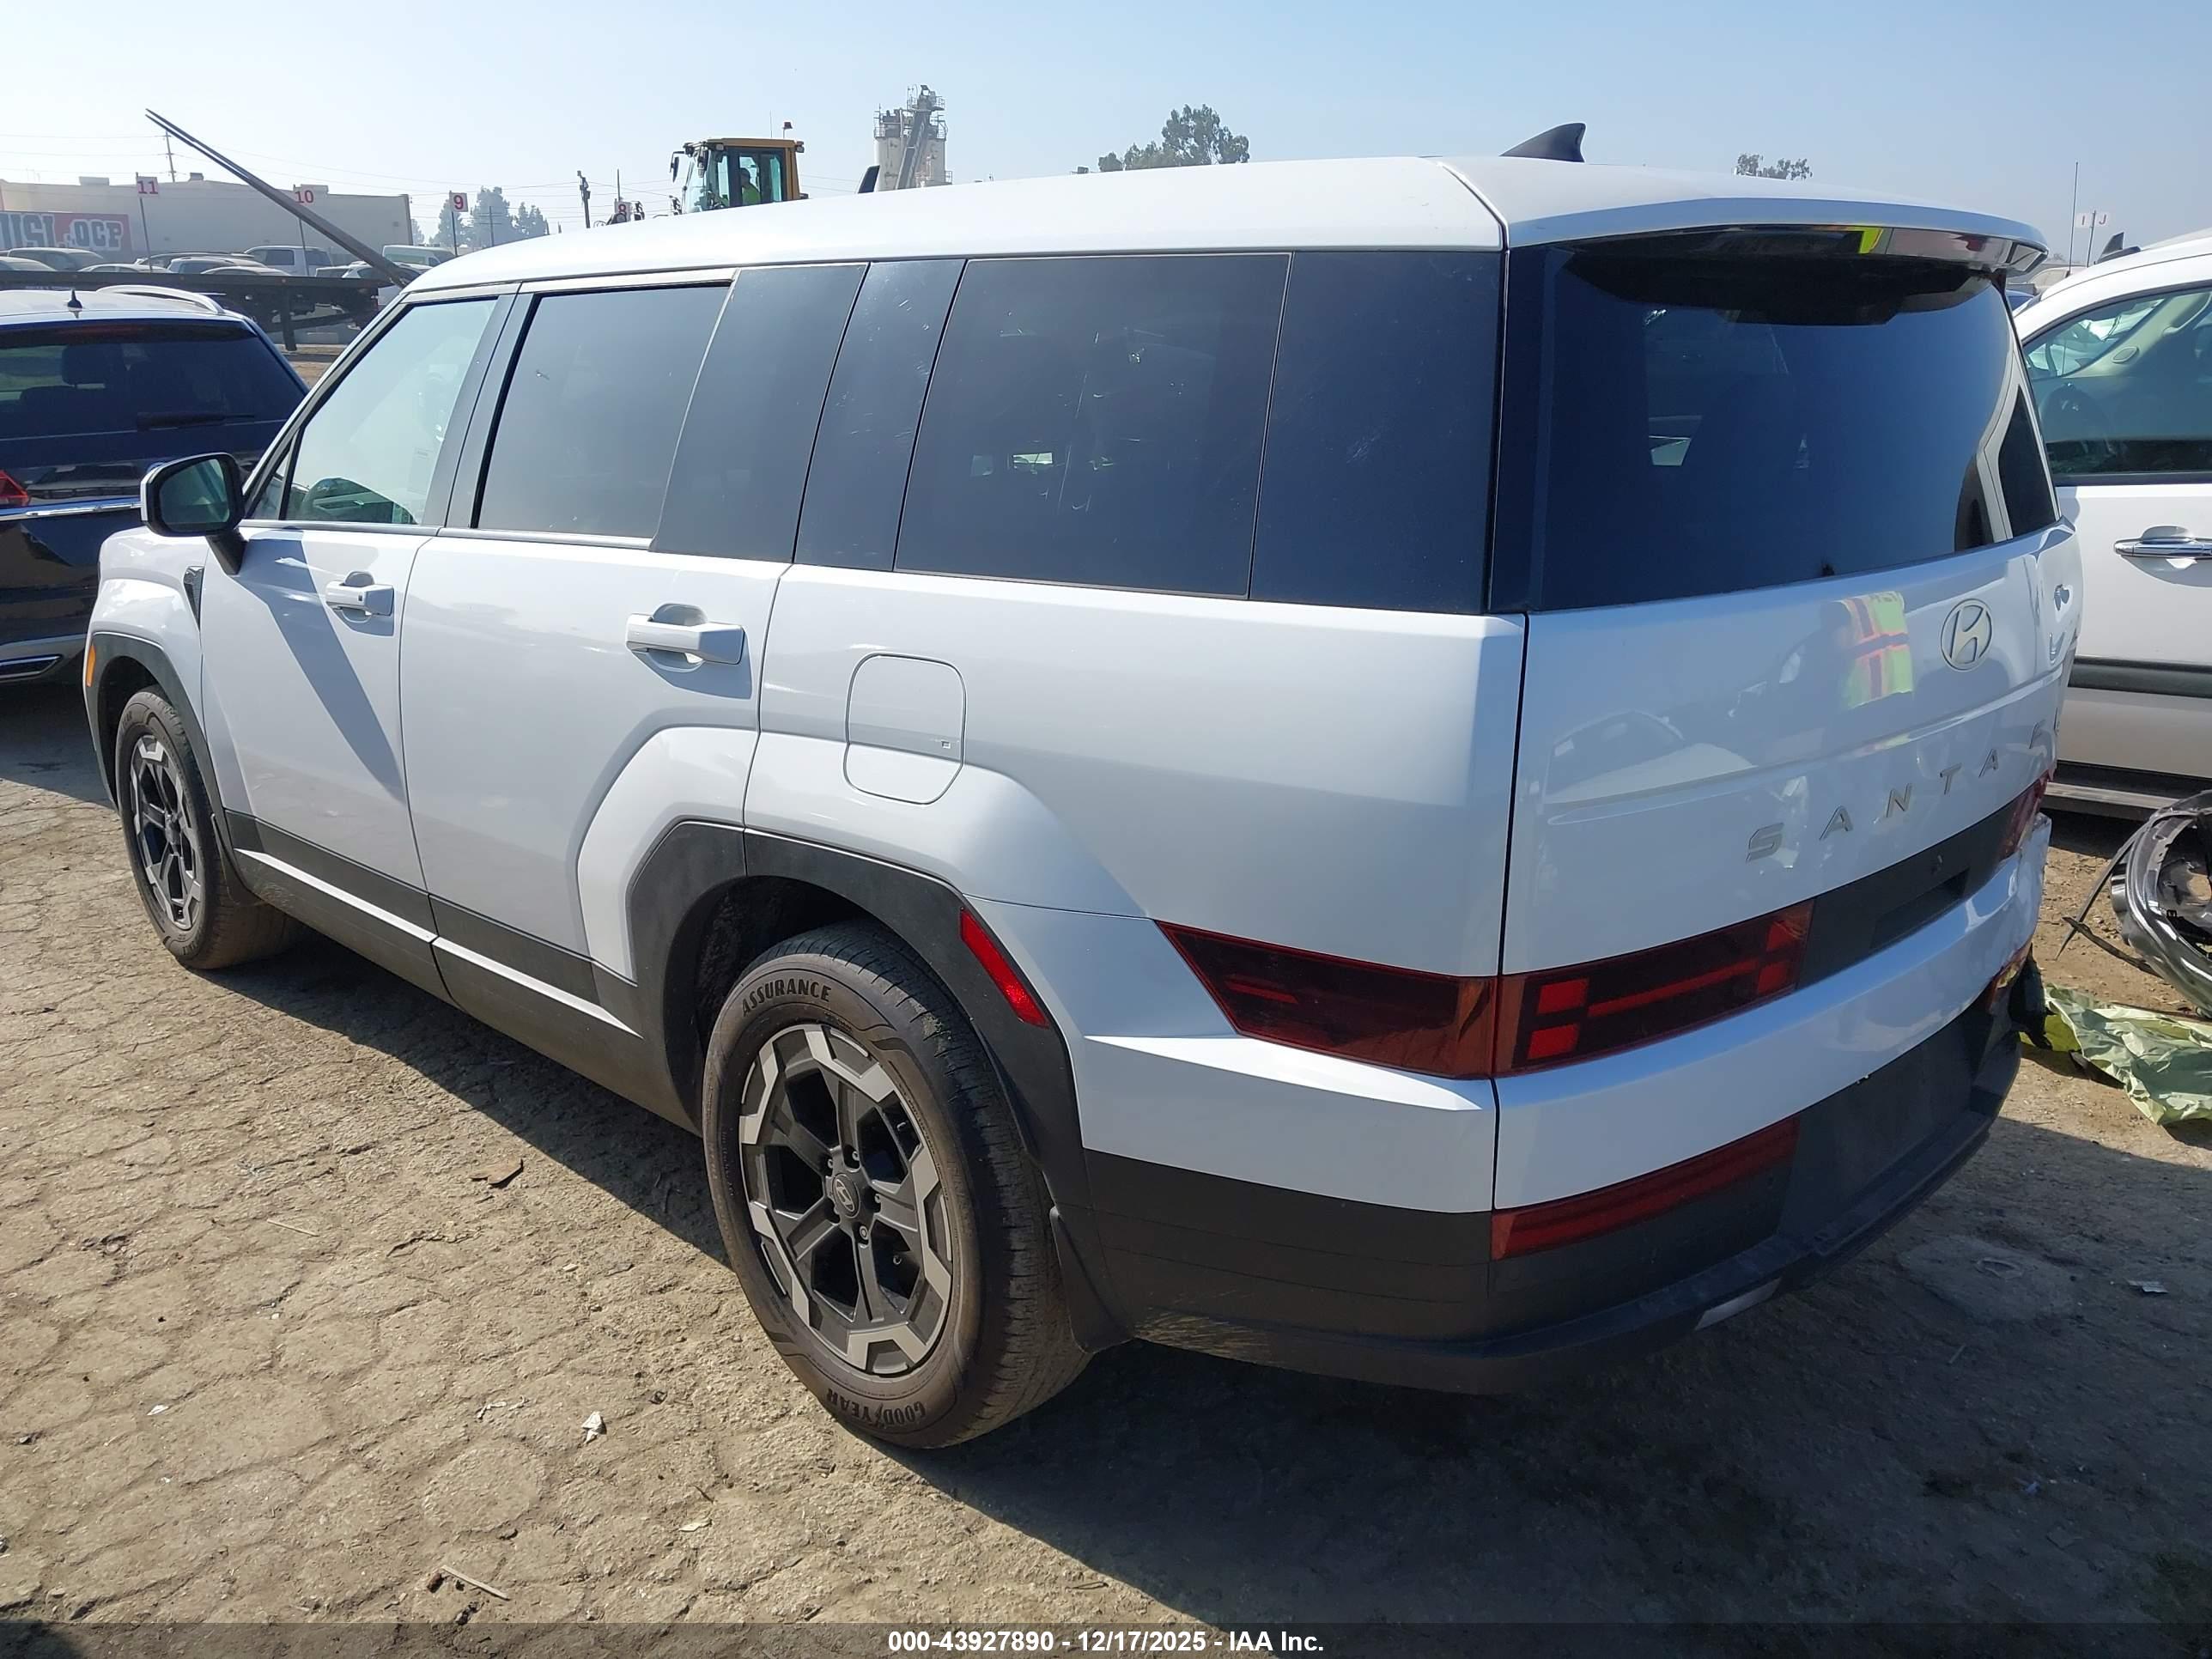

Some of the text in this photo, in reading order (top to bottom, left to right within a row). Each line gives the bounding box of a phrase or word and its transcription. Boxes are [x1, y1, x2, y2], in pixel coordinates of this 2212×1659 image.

[137, 180, 159, 195] 11
[295, 189, 314, 204] 10
[453, 195, 465, 210] 9
[2099, 215, 2106, 224] J
[1747, 748, 2000, 862] SANTA
[742, 978, 831, 1017] ASSURANCE
